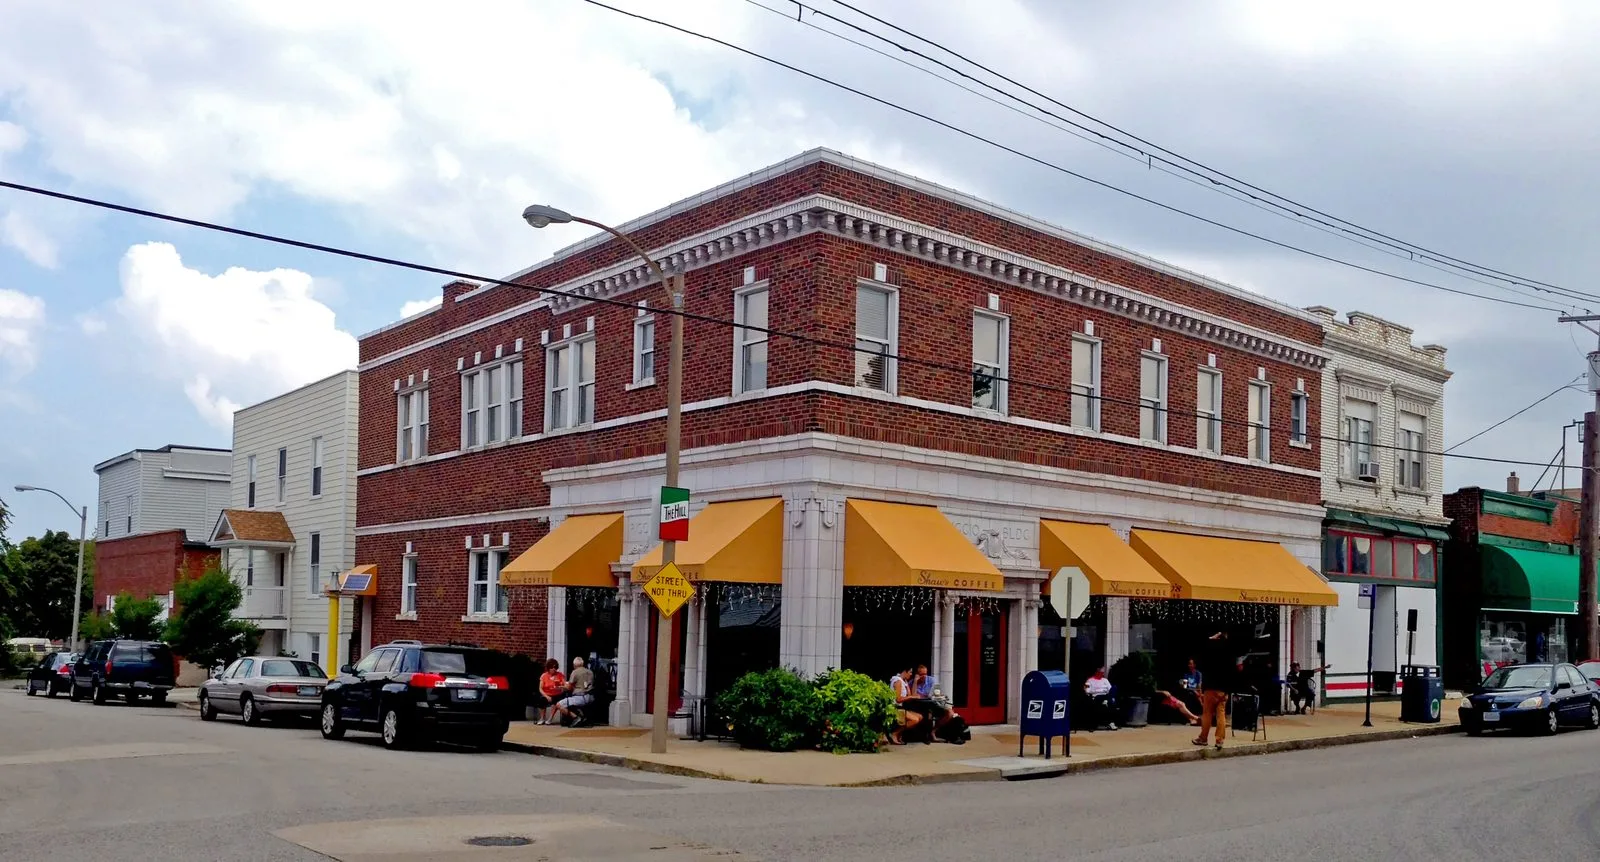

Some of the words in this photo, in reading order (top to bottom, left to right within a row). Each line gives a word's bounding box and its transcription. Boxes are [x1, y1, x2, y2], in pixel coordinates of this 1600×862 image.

[655, 576, 685, 587] STREET
[917, 569, 949, 586] Shaw's
[953, 579, 996, 589] COFFEE
[651, 588, 665, 597] NOT
[668, 588, 687, 598] THRU
[1135, 588, 1168, 596] COFFEE
